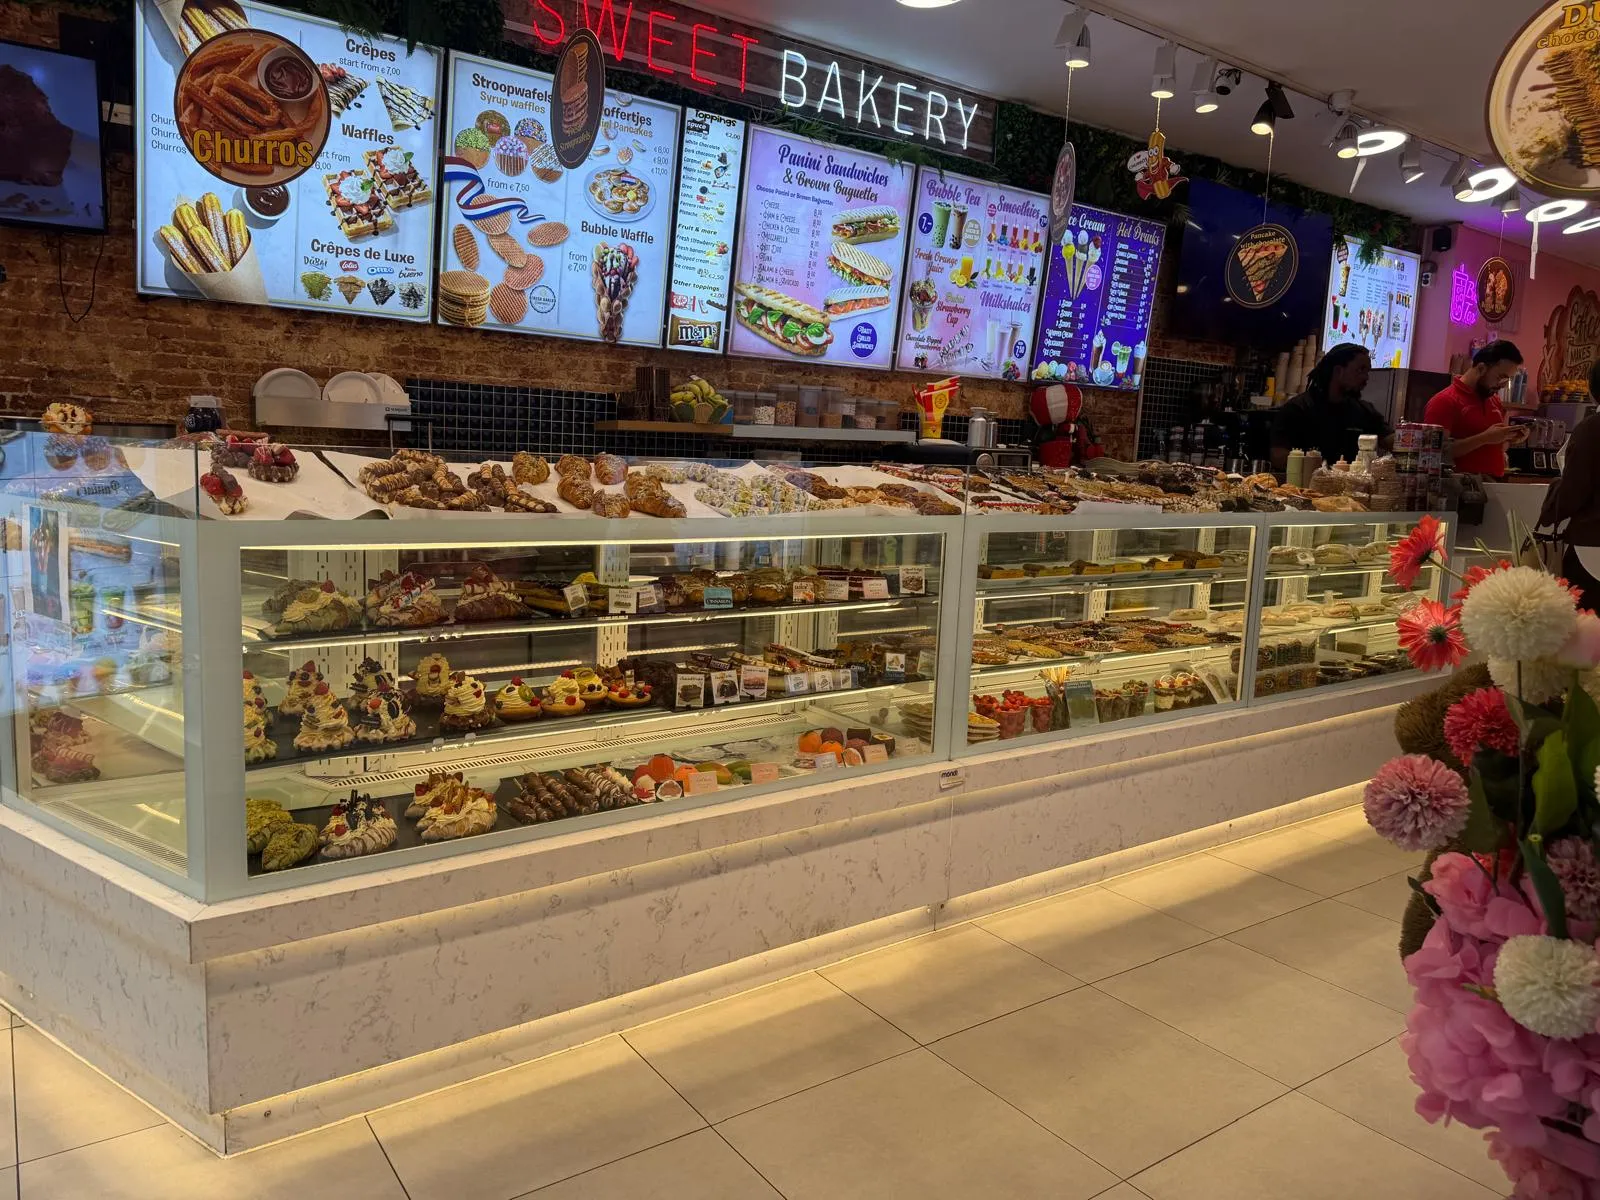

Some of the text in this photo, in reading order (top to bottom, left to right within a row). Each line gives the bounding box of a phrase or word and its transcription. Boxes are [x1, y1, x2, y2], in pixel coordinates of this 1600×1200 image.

[346, 38, 396, 62] Crêpes
[339, 57, 359, 68] start
[360, 61, 380, 73] from
[533, 0, 979, 151] SWEET BAKERY
[472, 73, 553, 104] Stroopwafels
[480, 91, 509, 107] Syrup
[695, 109, 737, 127] Toppings
[341, 123, 394, 145] Waffles
[613, 121, 653, 138] Pancakes
[151, 139, 187, 155] Churros
[192, 128, 315, 168] Churros
[331, 152, 351, 164] from
[779, 144, 889, 187] Panini Sandwiches
[487, 177, 508, 190] from
[783, 167, 878, 203] & Brown Baguettes
[927, 179, 981, 206] Bubble Tea
[997, 195, 1040, 219] Smoothies
[581, 220, 654, 244] Bubble Waffle
[678, 223, 694, 232] Fruit
[1079, 213, 1105, 232] Cream
[1116, 222, 1160, 246] Hot Drinks
[1251, 231, 1276, 239] Pancake
[311, 238, 415, 264] Crêpes de Luxe
[569, 250, 588, 262] from
[915, 248, 958, 268] Fresh Orange
[927, 261, 944, 275] Juice
[673, 279, 720, 292] Other toppings
[936, 300, 971, 318] Strawberry
[980, 291, 1031, 313] Milkshakes
[946, 313, 958, 327] Cup
